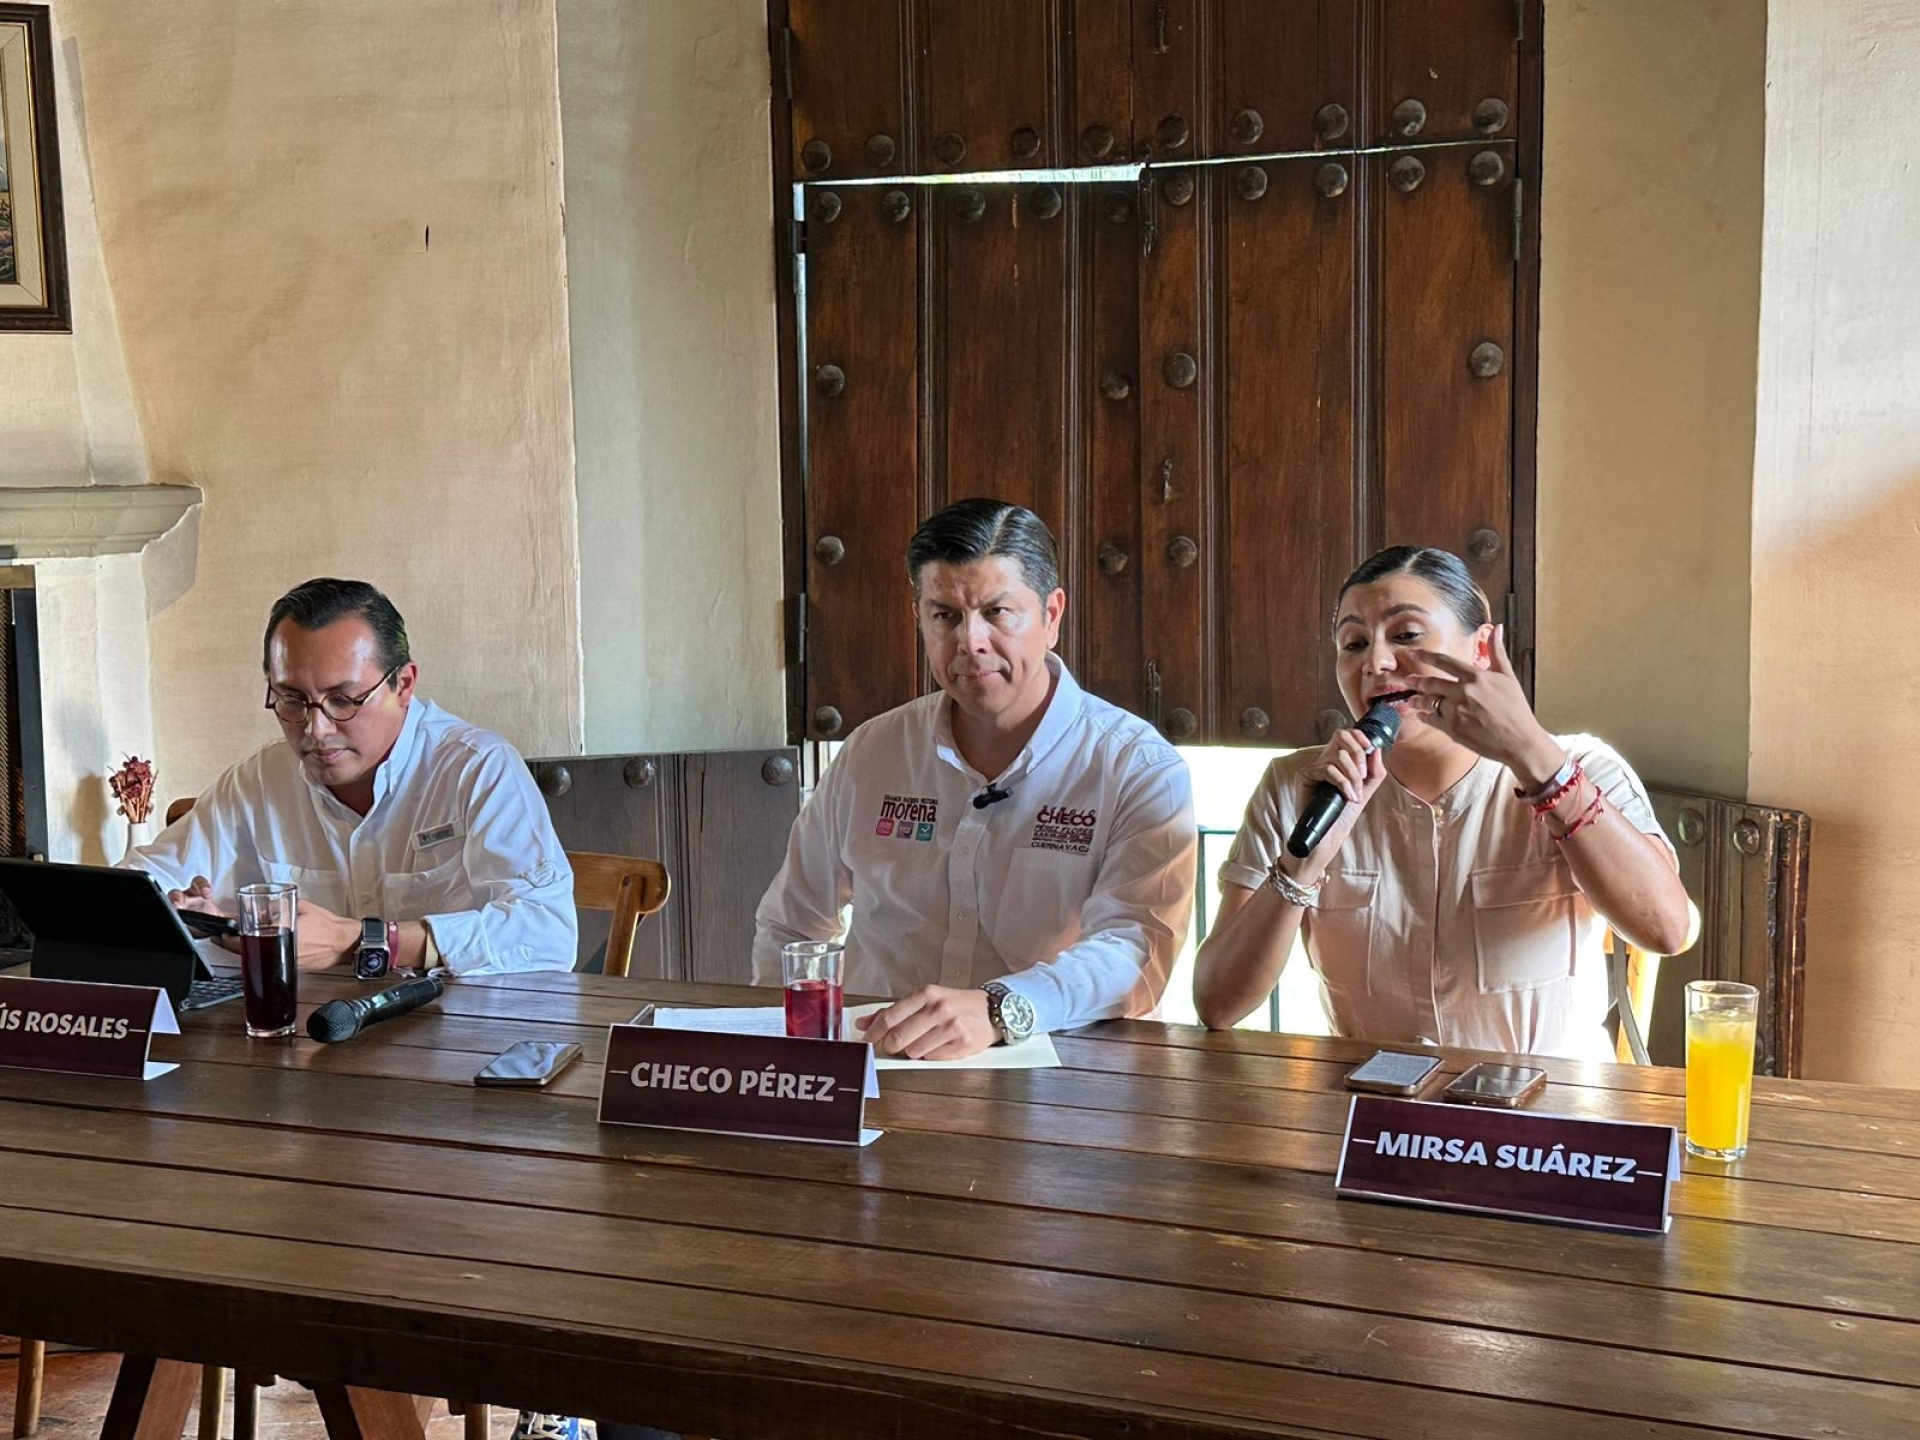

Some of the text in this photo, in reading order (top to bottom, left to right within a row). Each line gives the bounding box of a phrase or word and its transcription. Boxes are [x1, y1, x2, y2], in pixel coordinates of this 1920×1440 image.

[880, 800, 937, 823] morena
[1036, 810, 1096, 827] CHECO
[24, 1011, 129, 1040] ROSALES
[630, 1061, 836, 1102] CHECO PÉREZ
[1375, 1131, 1637, 1183] MIRSA SUÁREZ
